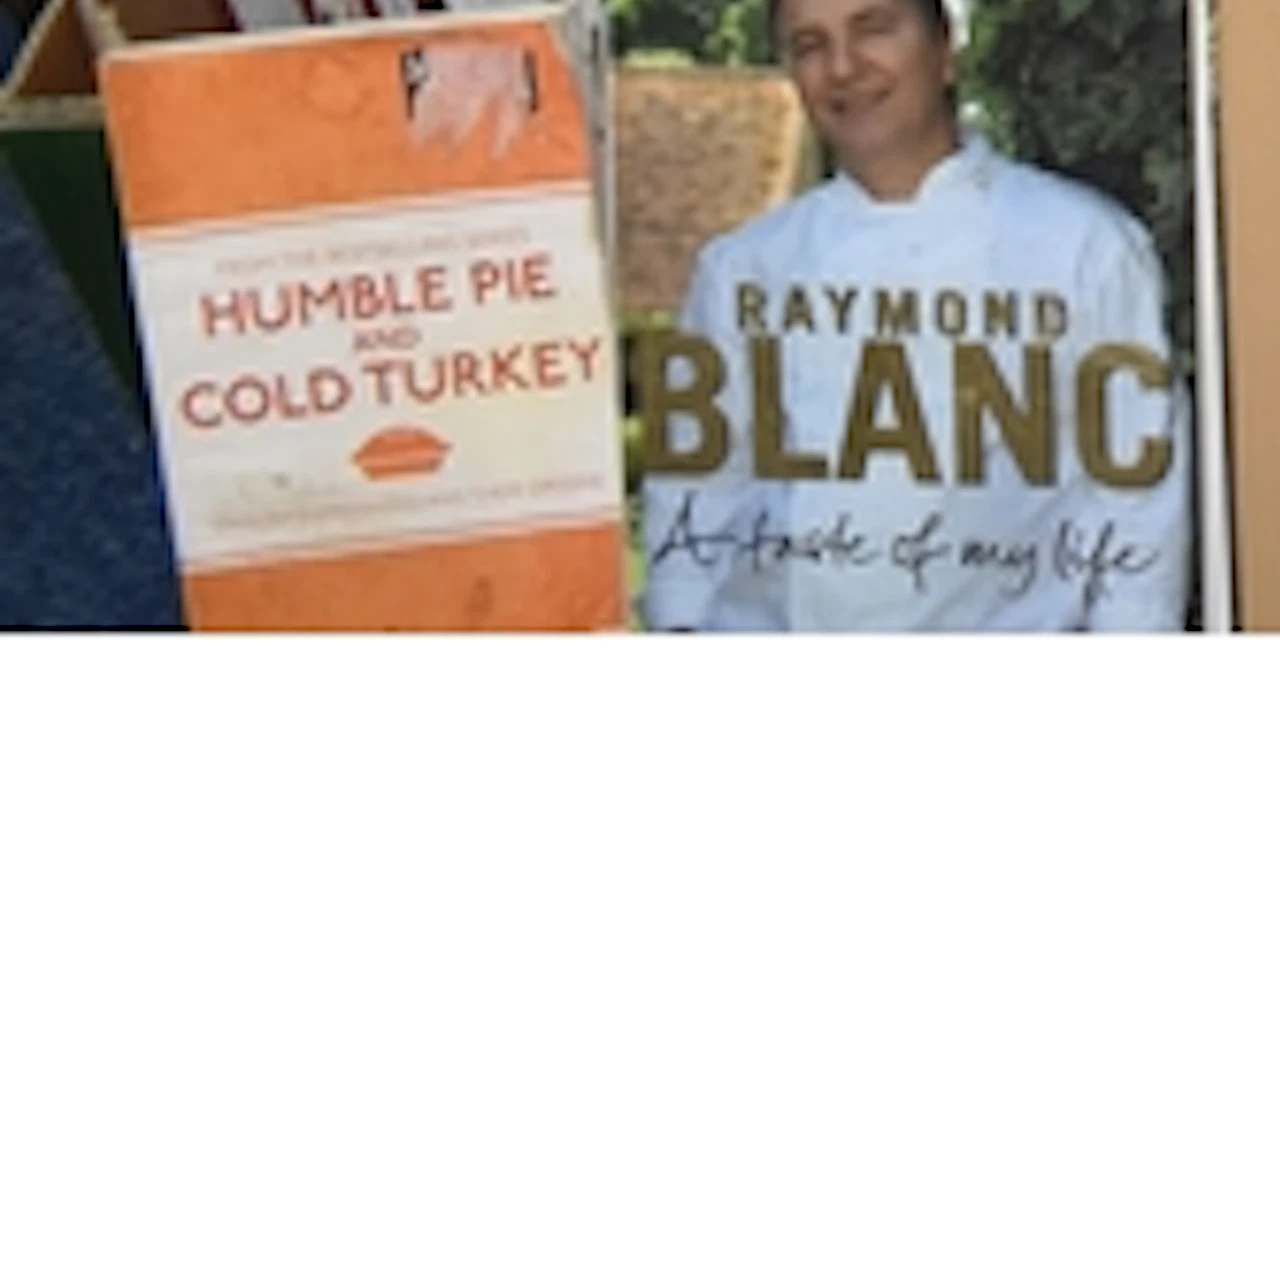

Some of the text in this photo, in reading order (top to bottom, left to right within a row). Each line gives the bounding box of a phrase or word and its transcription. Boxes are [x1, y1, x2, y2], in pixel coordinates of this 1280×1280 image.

[201, 251, 557, 337] HUMBLE PIE
[735, 281, 1069, 338] RAYMOND
[180, 336, 604, 429] COLD TURKEY
[351, 326, 422, 352] AND
[642, 330, 1174, 491] BLANC
[653, 488, 1160, 612] A taste of my life
